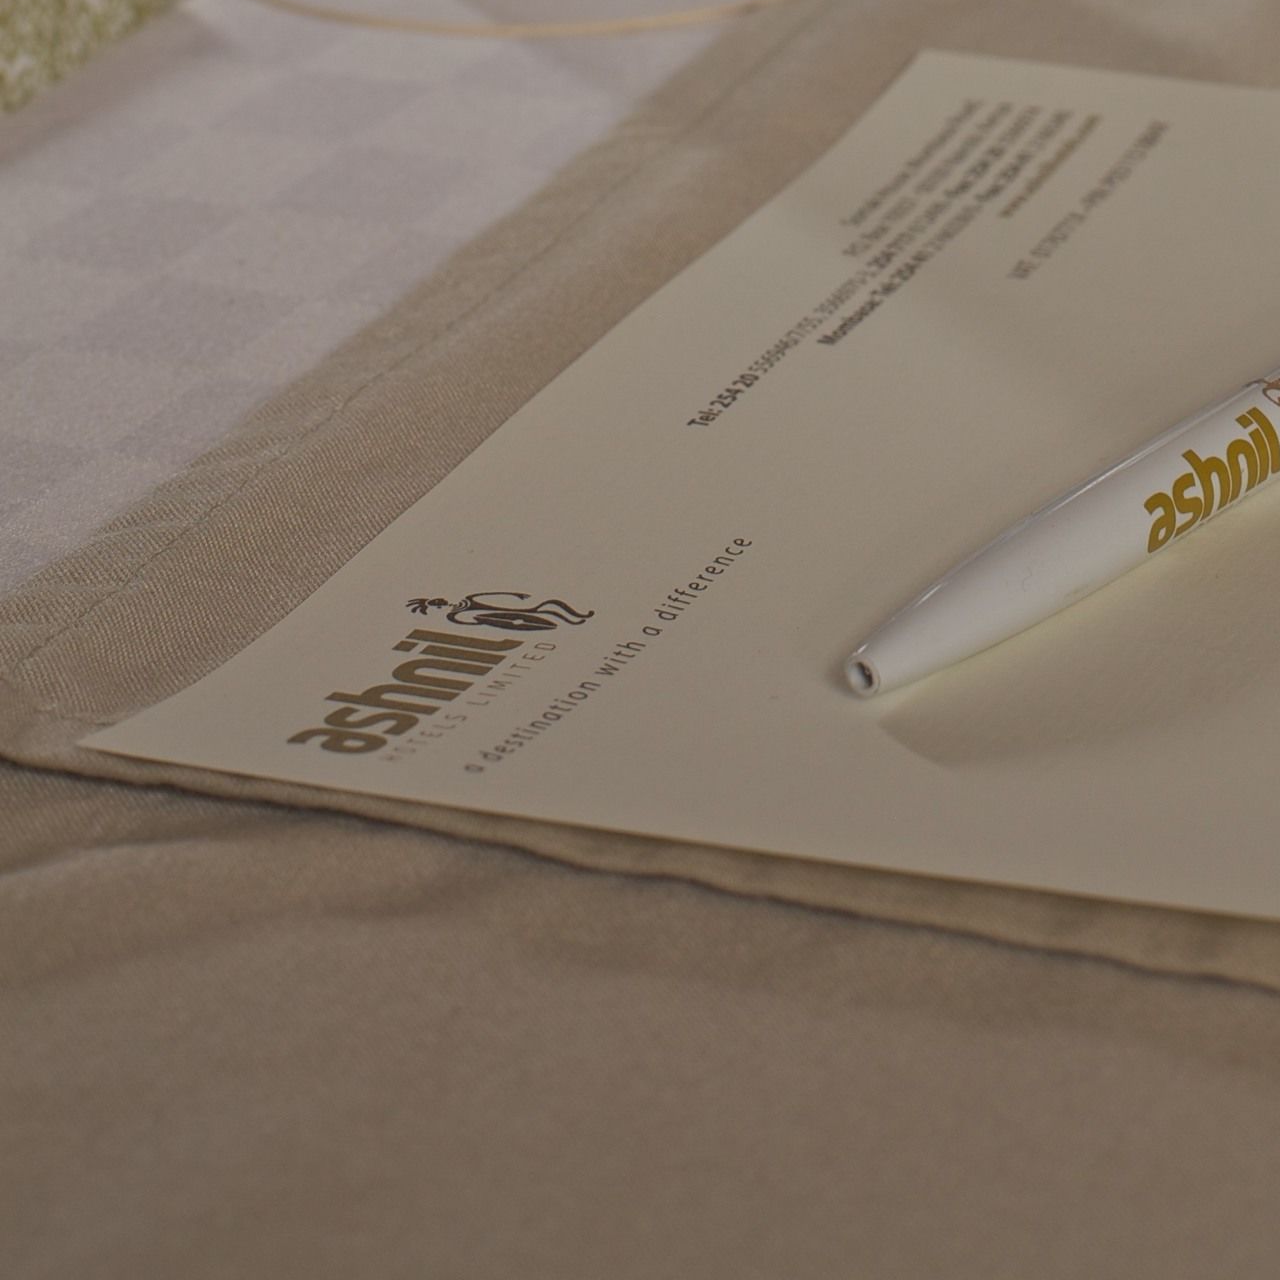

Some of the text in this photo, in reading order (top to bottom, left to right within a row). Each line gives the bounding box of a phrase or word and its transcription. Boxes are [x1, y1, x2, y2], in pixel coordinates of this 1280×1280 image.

[687, 406, 723, 427] Tel:
[710, 387, 744, 408] 254
[733, 372, 760, 388] 20
[287, 628, 525, 755] ashnil
[378, 640, 559, 764] HOTELS LIMITED
[464, 535, 754, 774] a destination with a difference
